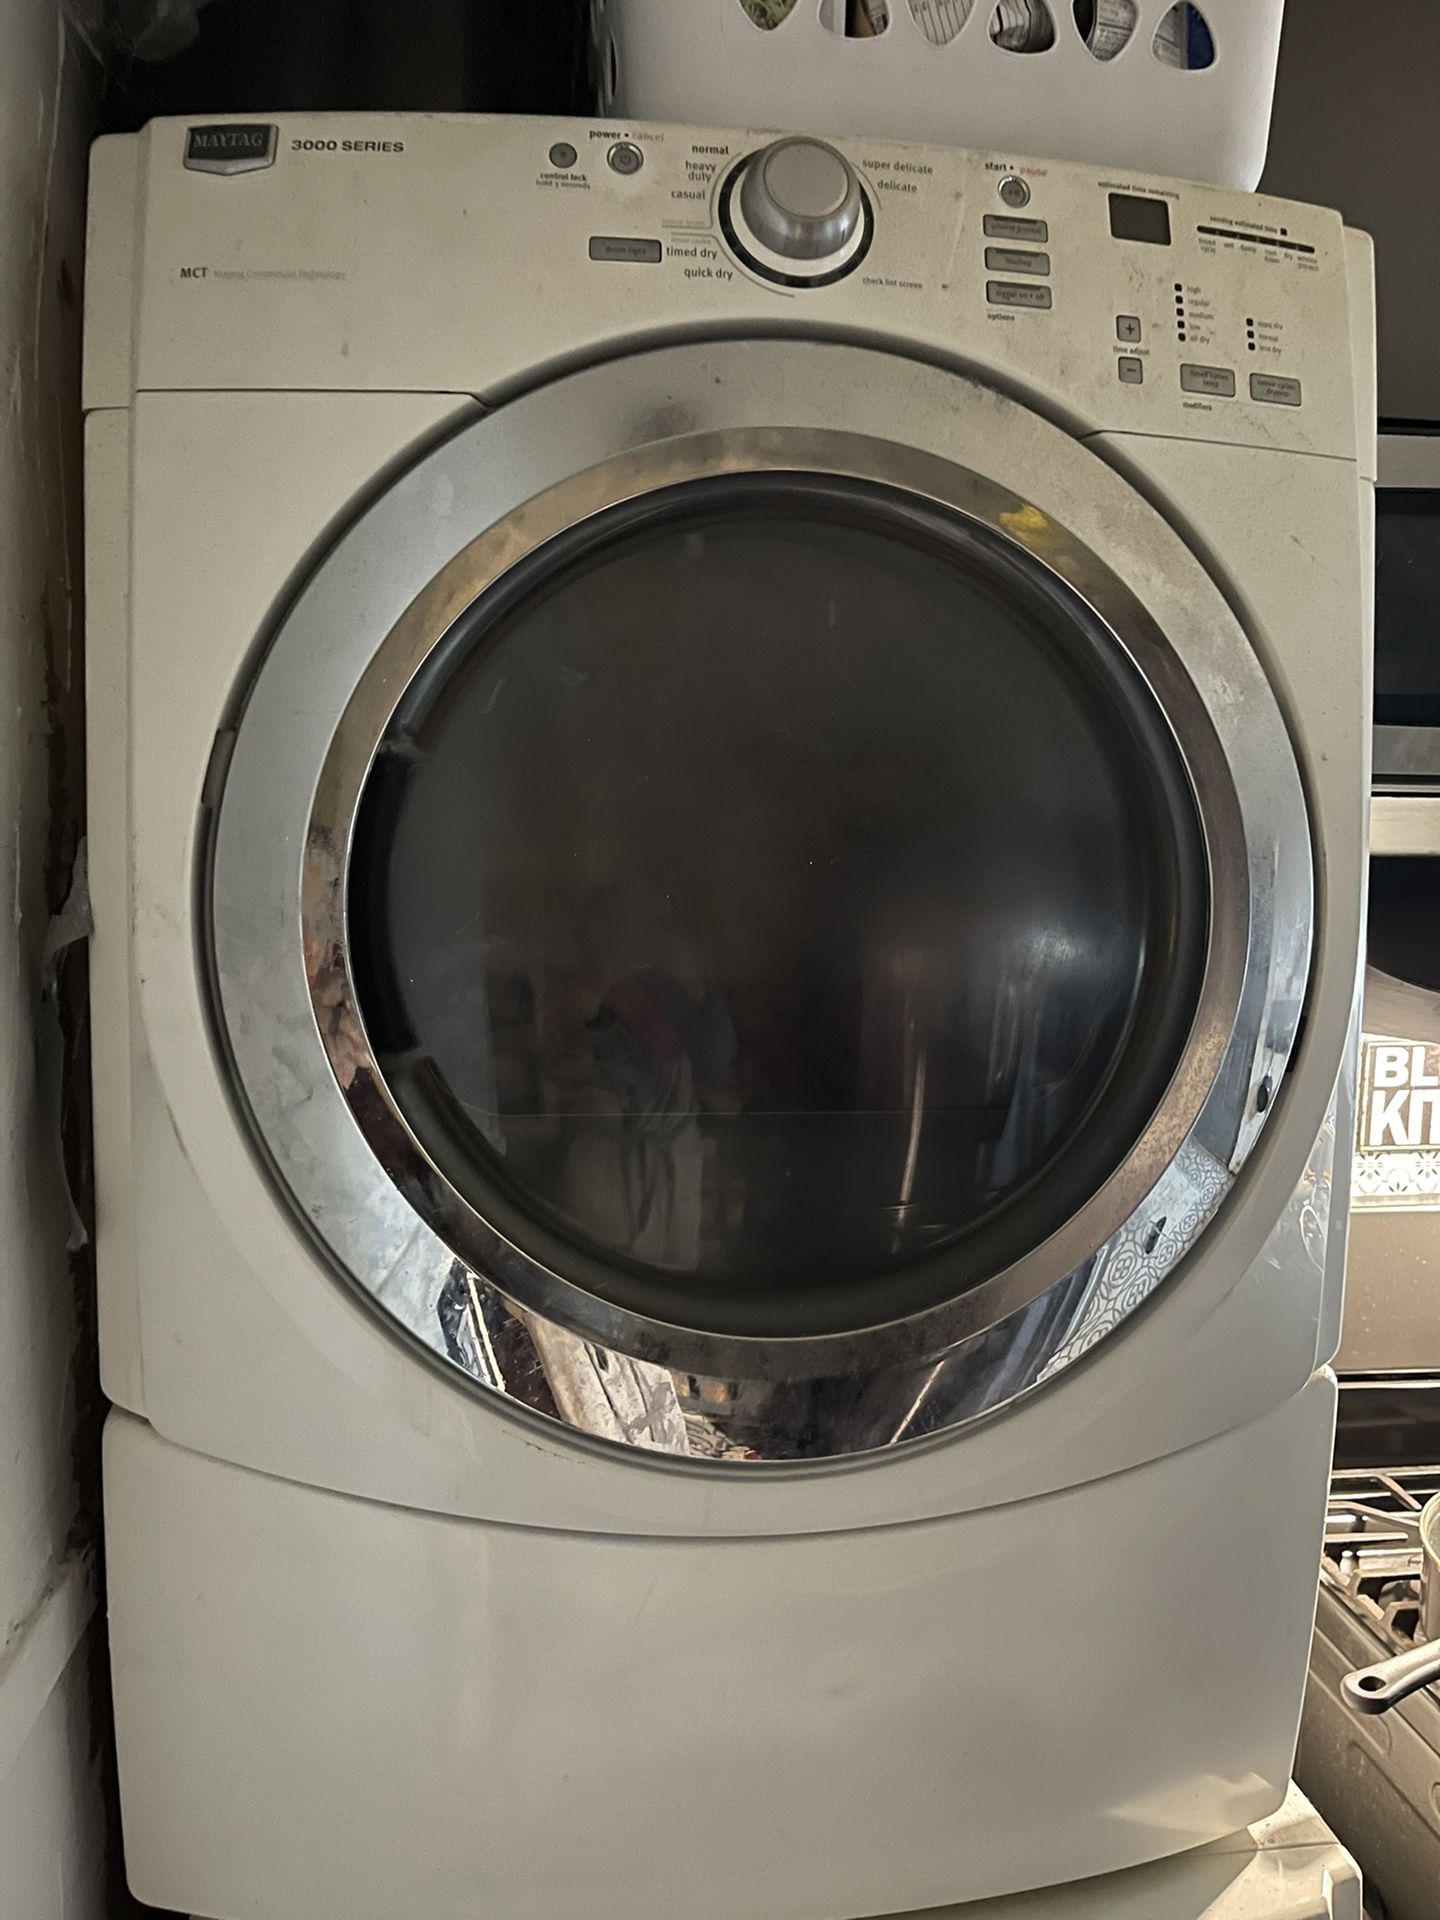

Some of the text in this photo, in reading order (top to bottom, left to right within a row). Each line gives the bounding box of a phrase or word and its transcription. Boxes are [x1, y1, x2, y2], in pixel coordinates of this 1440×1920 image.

[194, 132, 264, 148] MAYTAG
[589, 130, 621, 140] power
[291, 140, 404, 152] 3000 SERIES
[692, 145, 729, 155] normal
[685, 160, 716, 173] heavy
[862, 159, 933, 175] super delicate
[985, 162, 1007, 172] start
[570, 173, 588, 182] lock
[688, 172, 712, 183] duty
[877, 180, 917, 193] delicate
[671, 190, 706, 199] casual
[666, 247, 718, 259] timed dry
[180, 267, 208, 278] MCT
[684, 267, 733, 280] quick dry
[988, 313, 1015, 322] options
